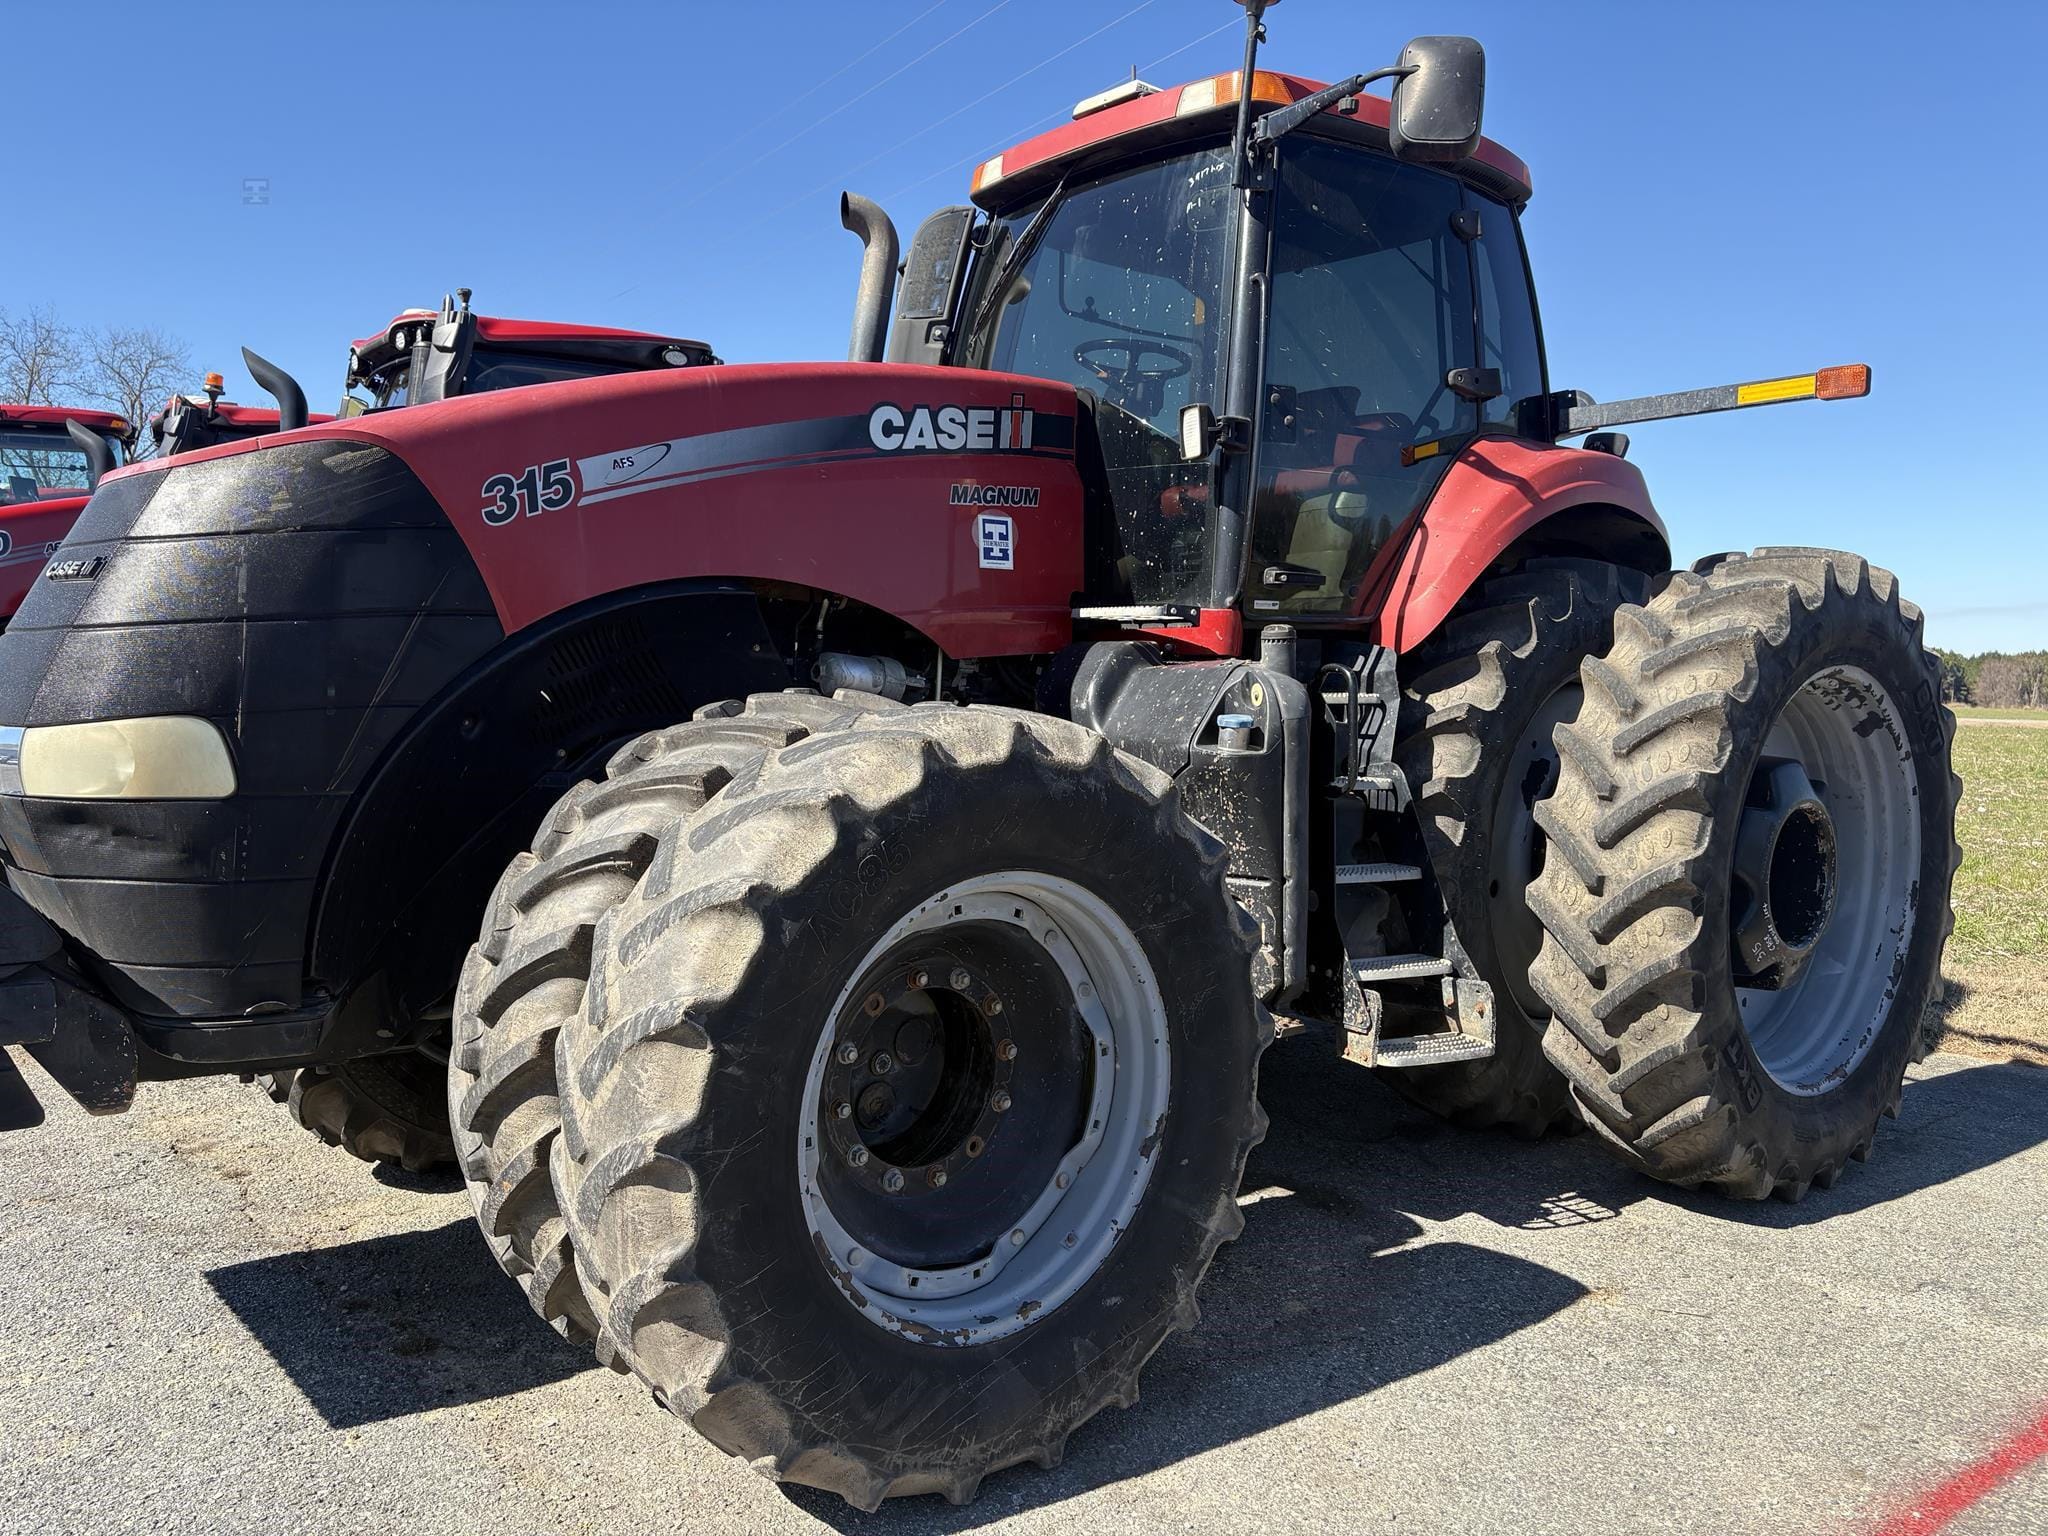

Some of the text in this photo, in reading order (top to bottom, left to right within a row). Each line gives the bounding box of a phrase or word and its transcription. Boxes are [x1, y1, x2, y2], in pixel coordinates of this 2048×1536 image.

[869, 405, 995, 451] CASE
[612, 456, 635, 470] AFS
[481, 458, 576, 527] 315
[949, 483, 1041, 508] MAGNUM
[44, 541, 64, 554] AF
[1725, 1035, 1762, 1113] BKT
